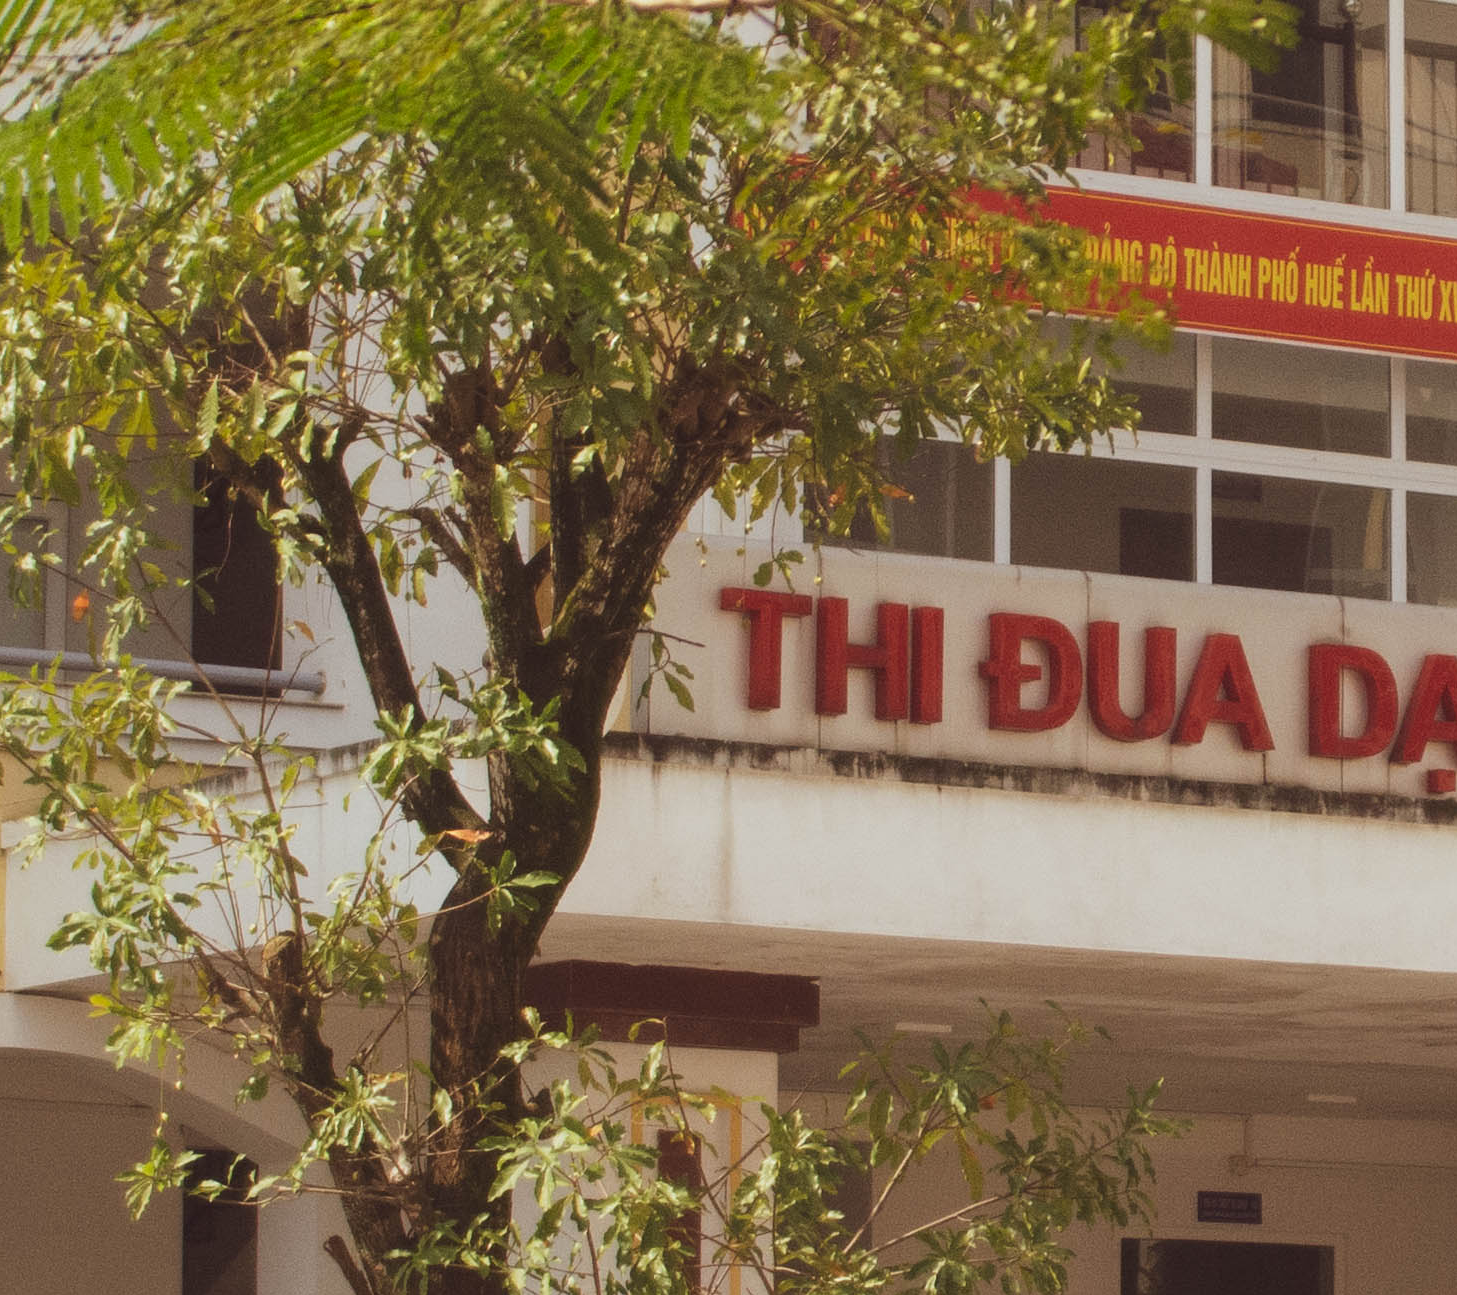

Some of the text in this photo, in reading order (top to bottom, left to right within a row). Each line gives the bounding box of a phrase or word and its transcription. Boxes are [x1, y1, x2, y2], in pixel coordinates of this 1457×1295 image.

[1150, 235, 1178, 299] BỘ
[1184, 241, 1251, 298] THÀNH
[1257, 246, 1301, 304] PHỐ
[1305, 254, 1346, 310] HUẾ
[1350, 255, 1390, 315] LẦN
[1396, 268, 1436, 321] THỨ
[720, 586, 944, 725] THI
[978, 611, 1276, 752] ĐUA
